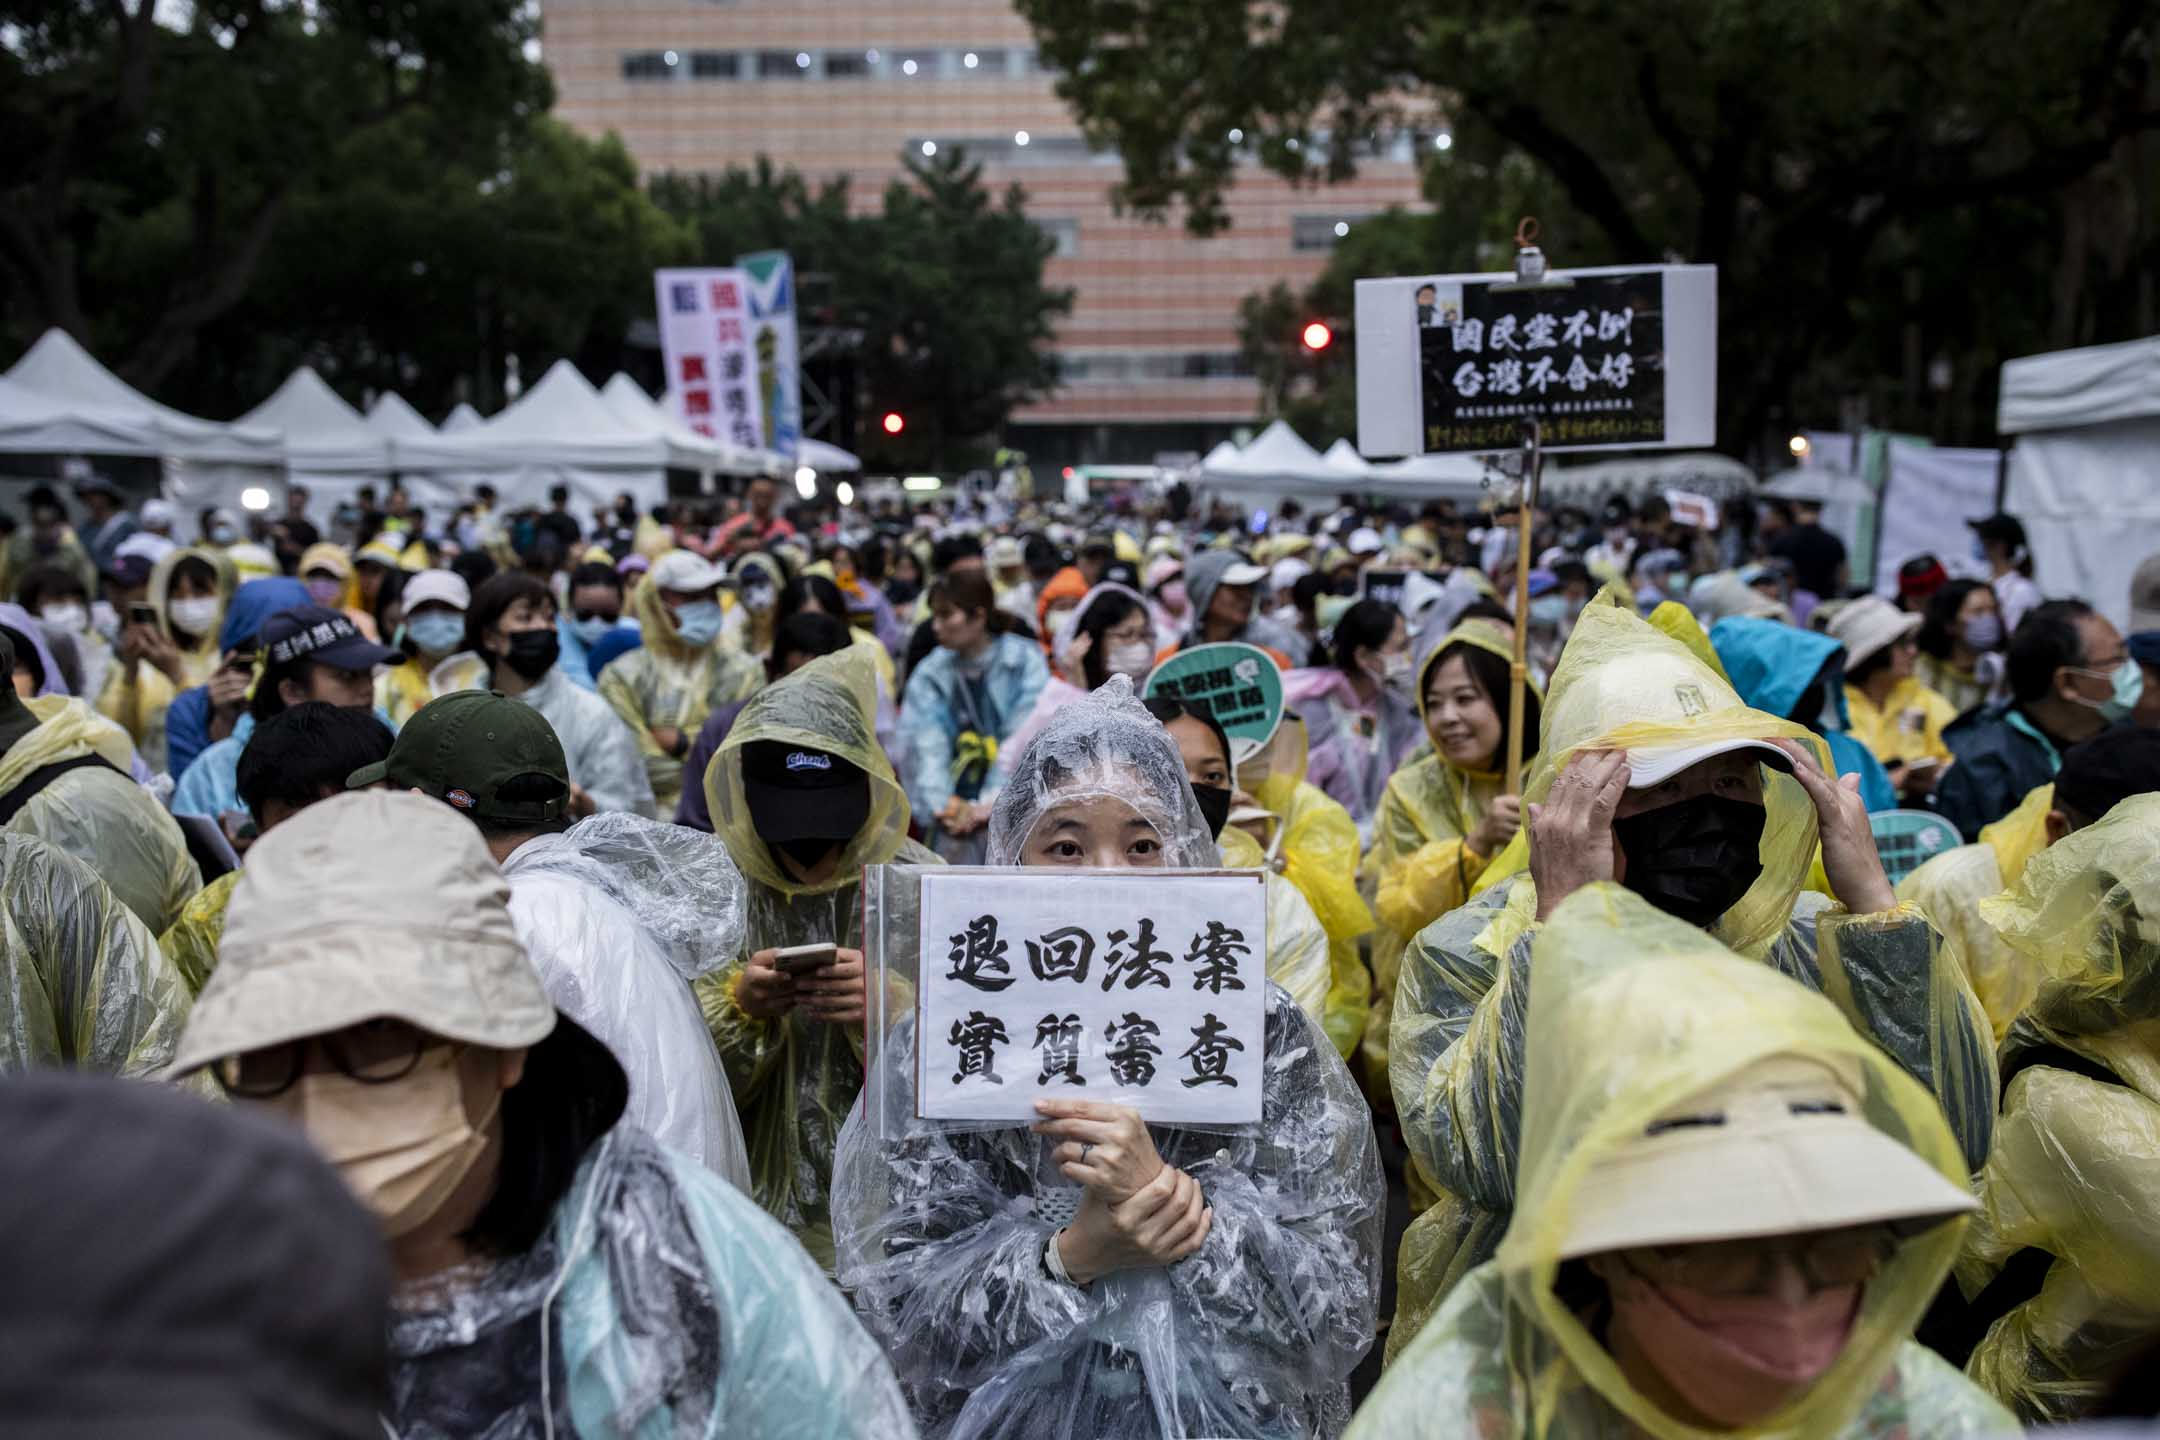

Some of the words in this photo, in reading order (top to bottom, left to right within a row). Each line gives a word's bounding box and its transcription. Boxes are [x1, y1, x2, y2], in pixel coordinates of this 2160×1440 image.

[1453, 353, 1634, 396] 台灣不會好
[946, 915, 1251, 994] 退回法案
[948, 1010, 1244, 1088] 實質審查
